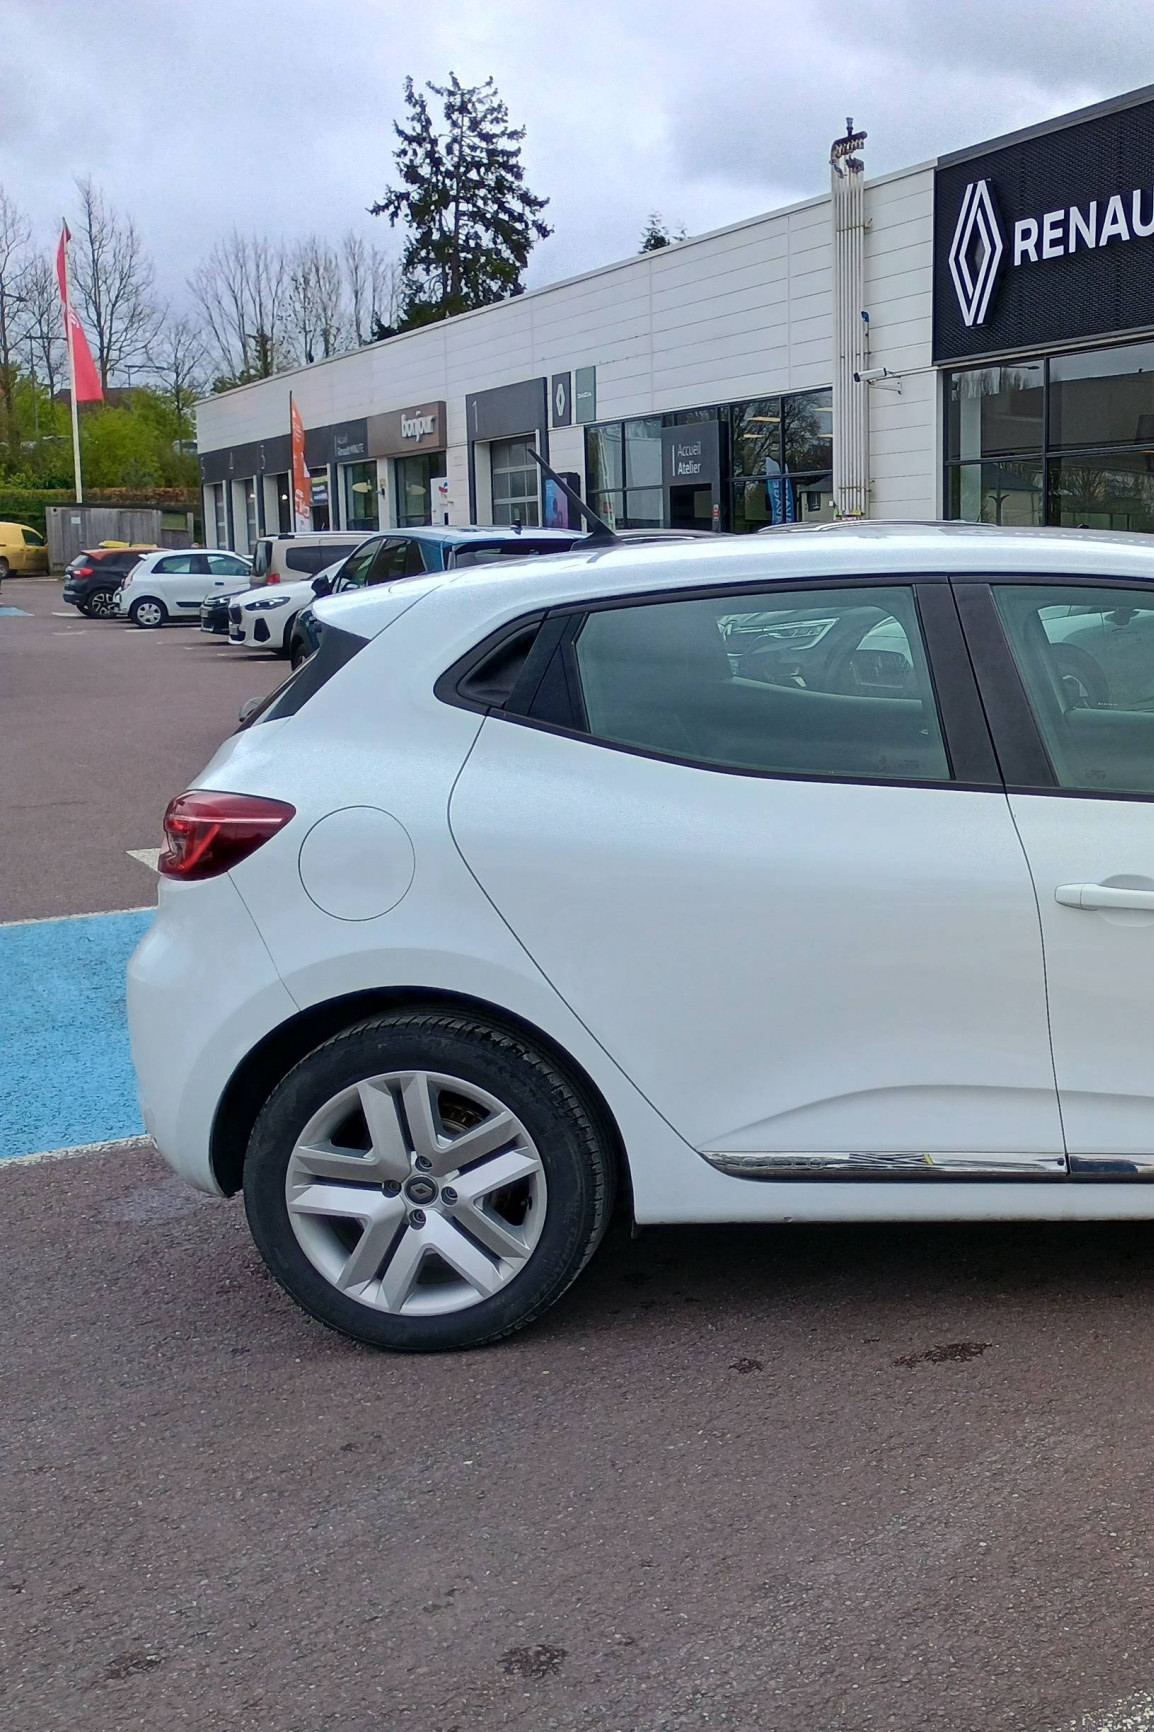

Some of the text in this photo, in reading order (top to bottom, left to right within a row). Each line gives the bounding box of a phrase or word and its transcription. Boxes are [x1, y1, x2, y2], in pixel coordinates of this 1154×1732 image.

[401, 411, 435, 442] bonjour
[472, 400, 478, 433] 1
[678, 441, 702, 456] Accueil
[678, 460, 702, 475] Atelier
